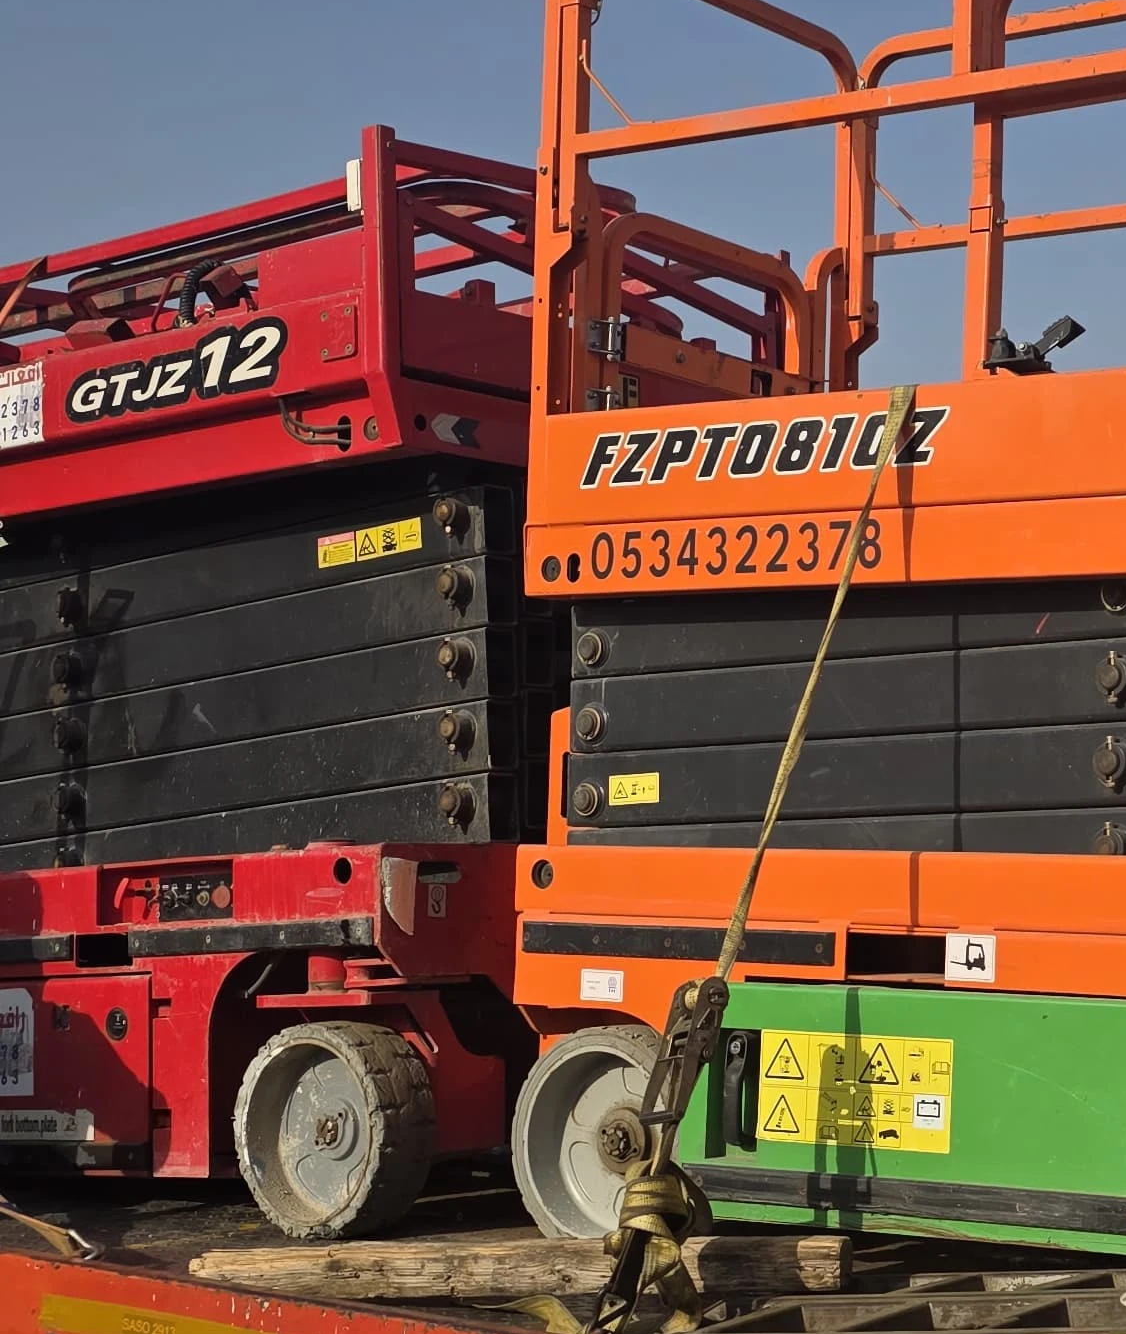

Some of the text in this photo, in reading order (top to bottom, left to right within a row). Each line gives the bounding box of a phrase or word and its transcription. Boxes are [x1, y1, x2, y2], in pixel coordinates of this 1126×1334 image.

[70, 325, 281, 413] GTJZ12
[590, 517, 883, 580] 0534322378
[122, 1317, 151, 1334] SASO
